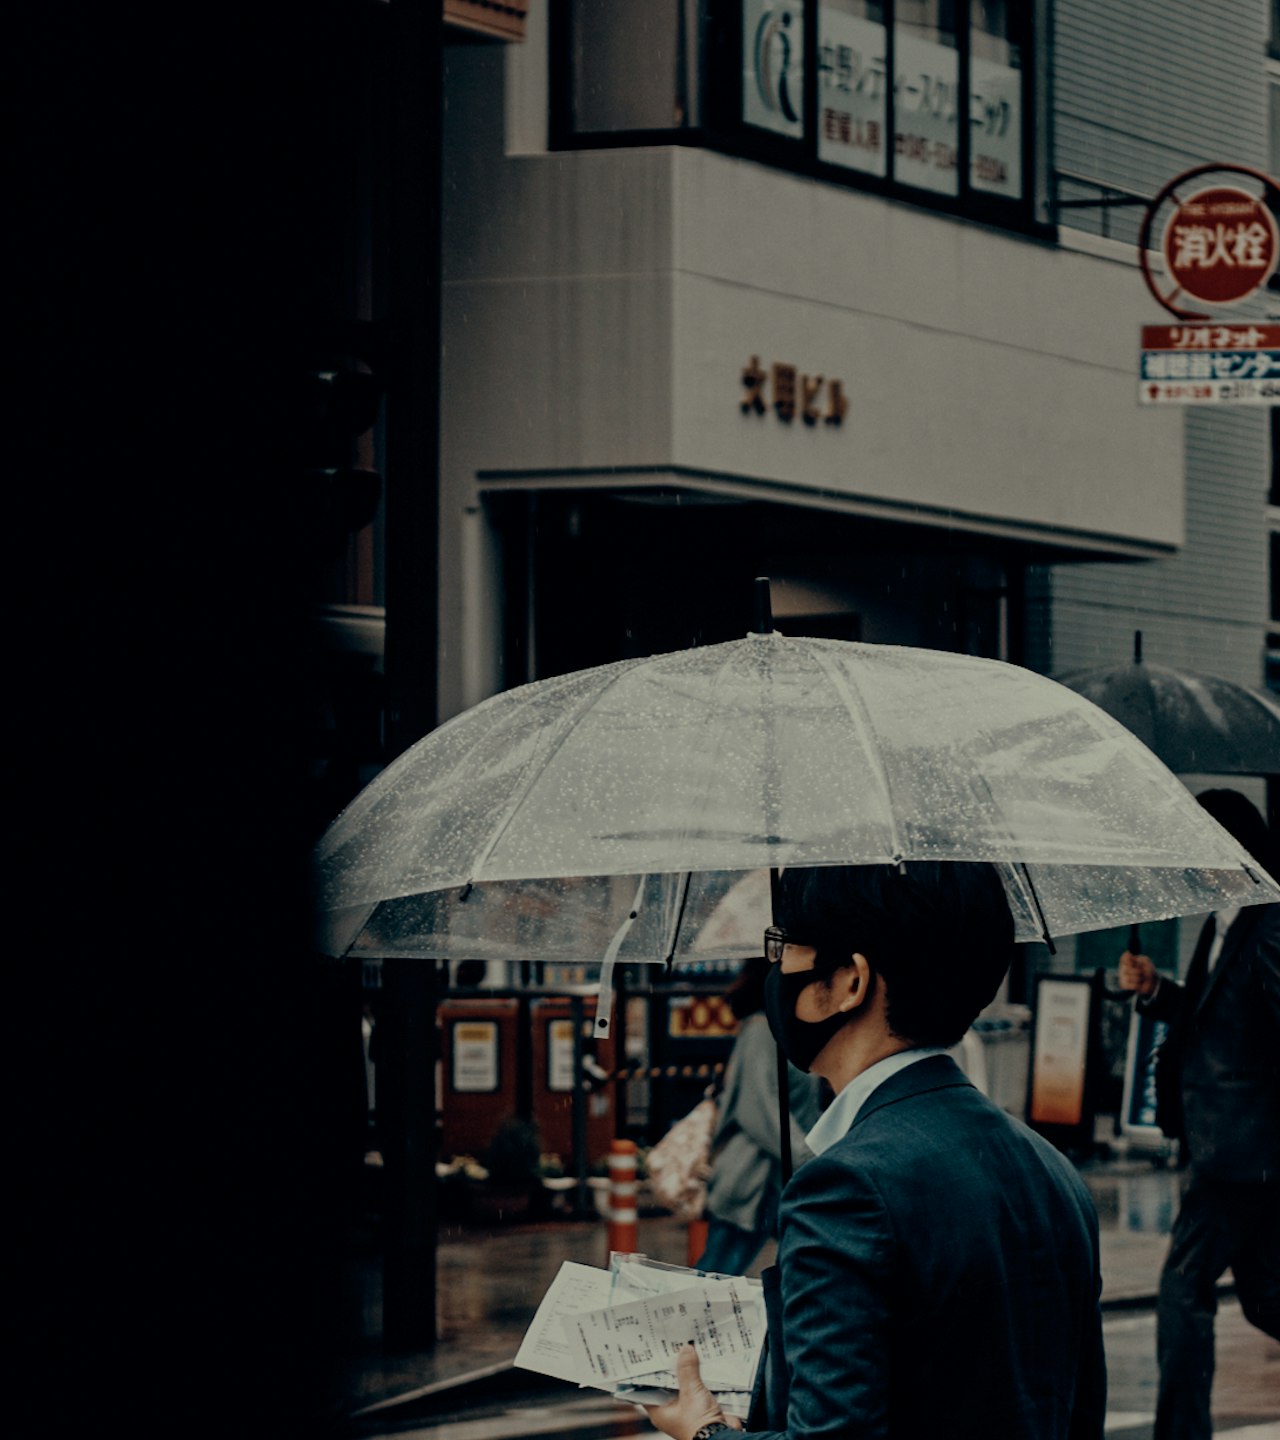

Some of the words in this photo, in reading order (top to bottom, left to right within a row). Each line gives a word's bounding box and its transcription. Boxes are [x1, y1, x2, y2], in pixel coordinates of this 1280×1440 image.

[1172, 221, 1270, 269] 消火栓
[1168, 326, 1267, 349] リオネット
